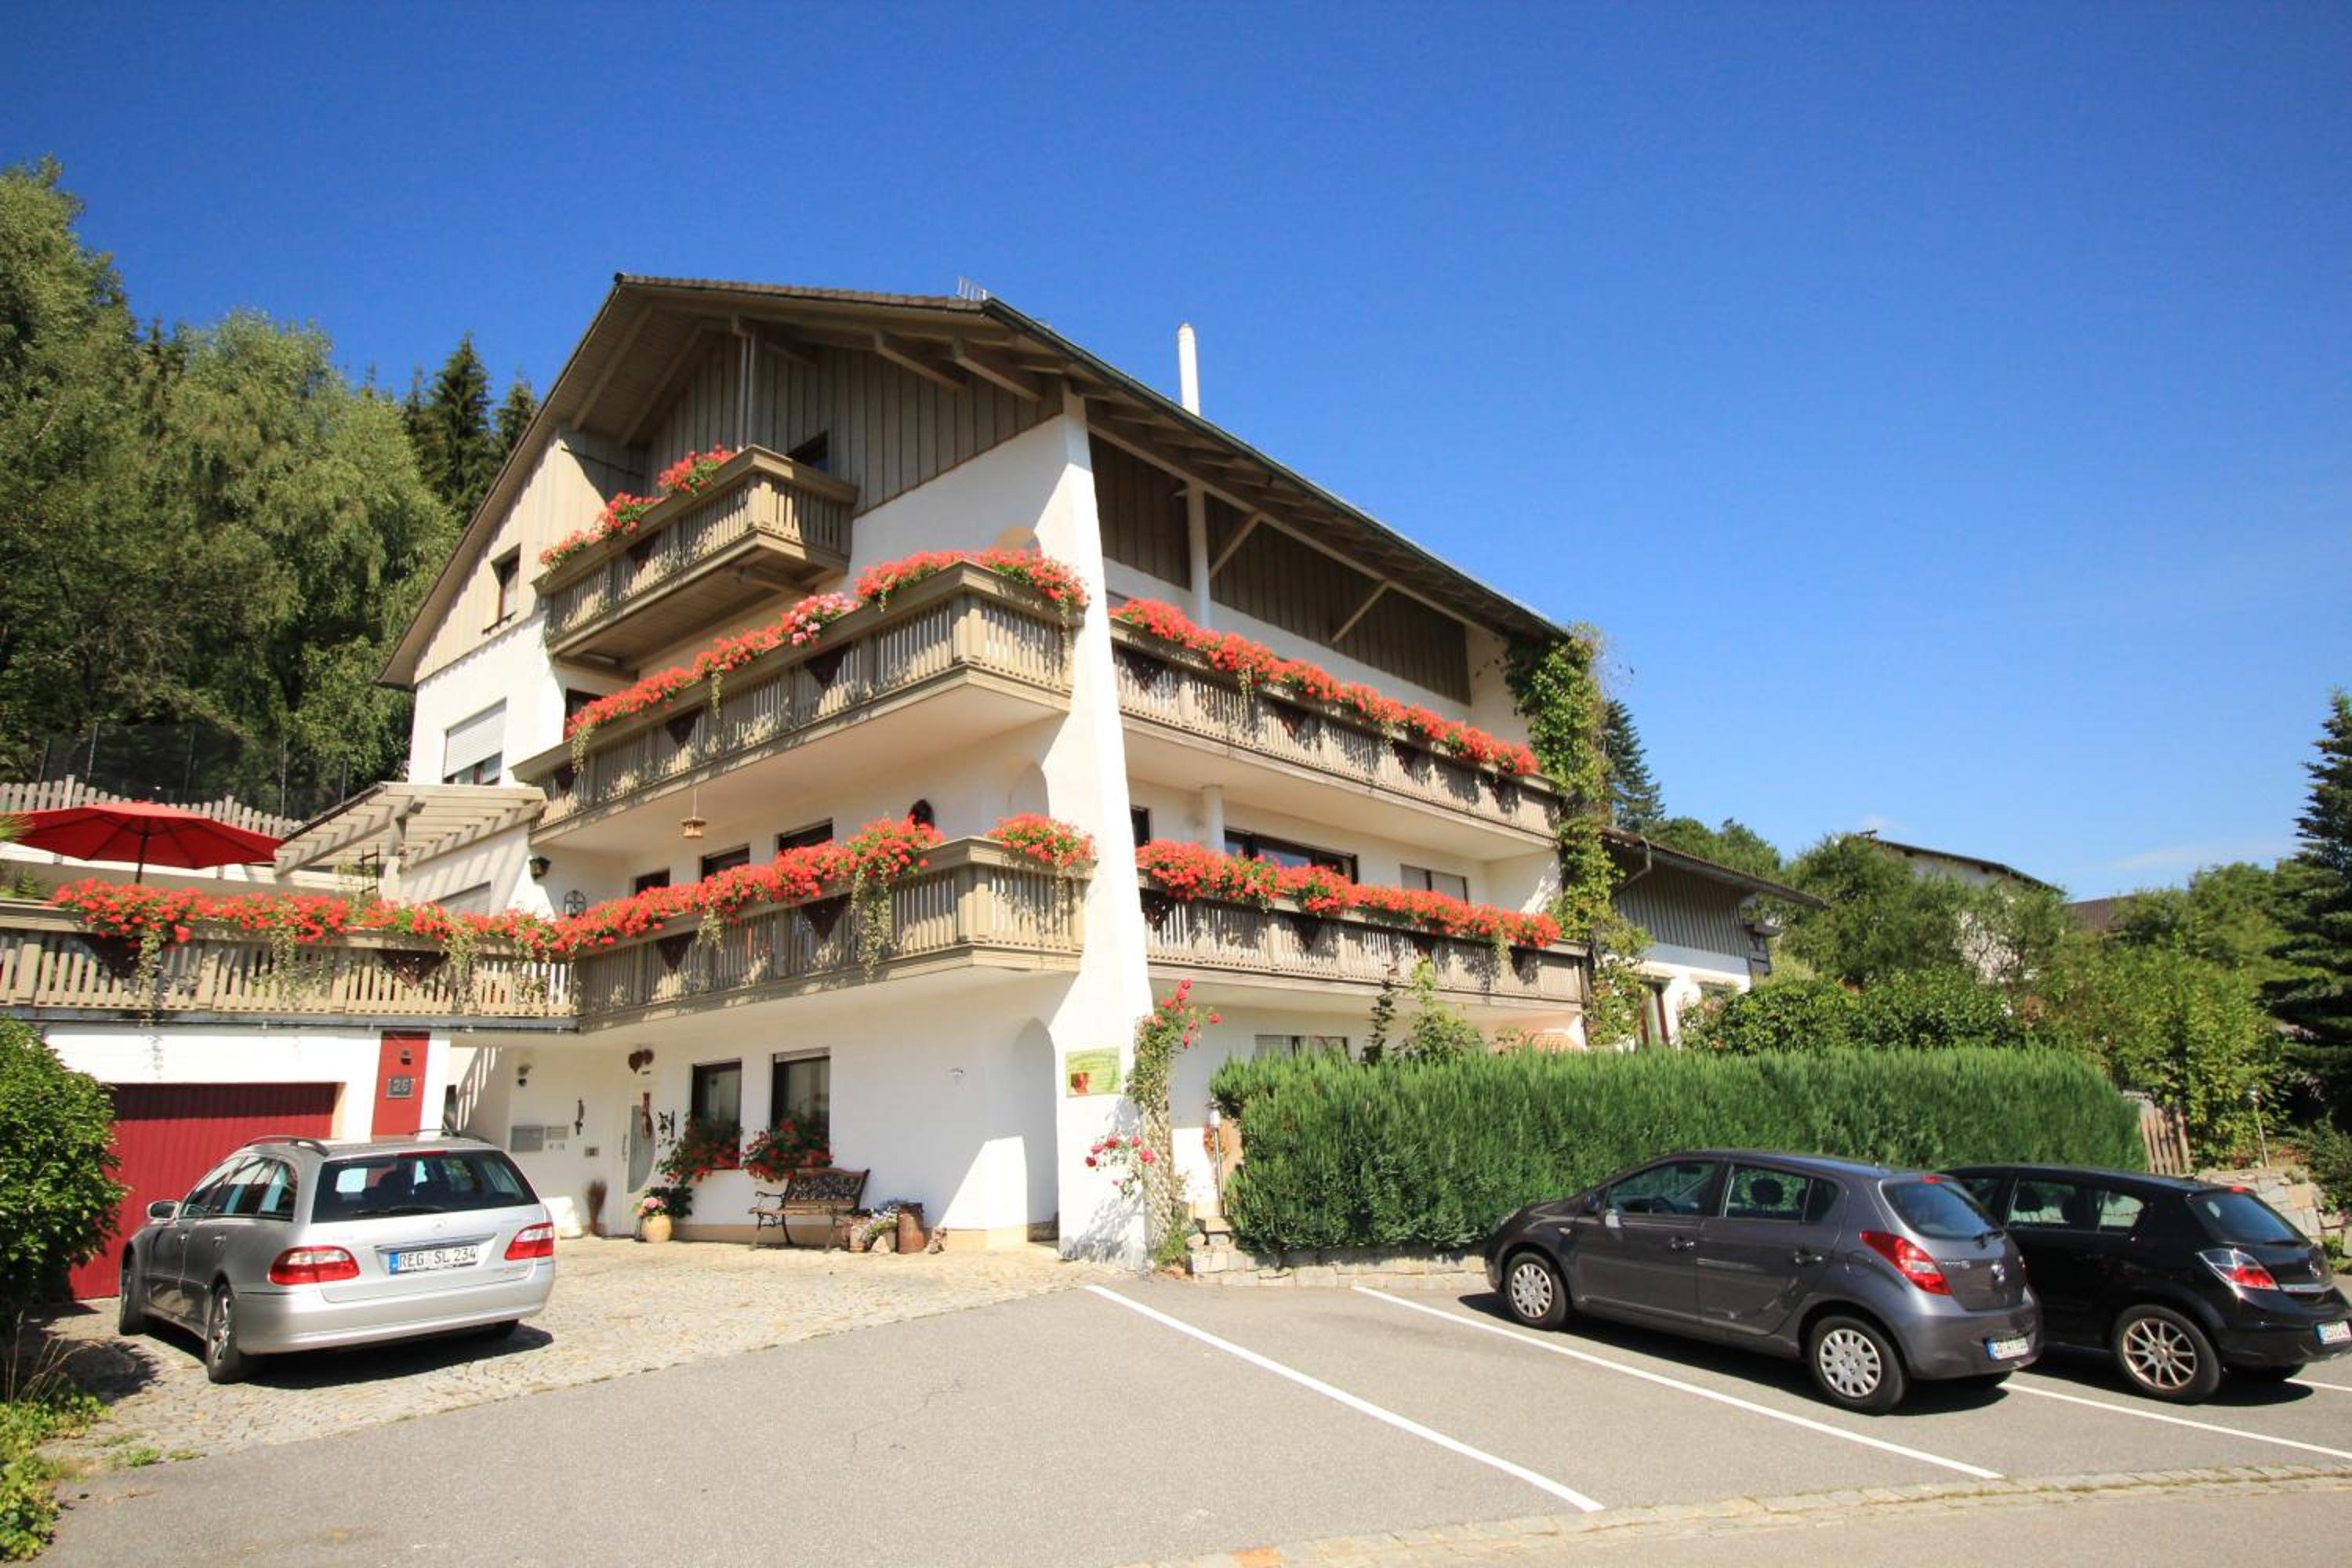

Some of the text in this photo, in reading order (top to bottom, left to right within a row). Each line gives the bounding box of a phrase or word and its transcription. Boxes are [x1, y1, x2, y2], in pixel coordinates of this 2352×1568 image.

[399, 1247, 477, 1269] REG SL 234
